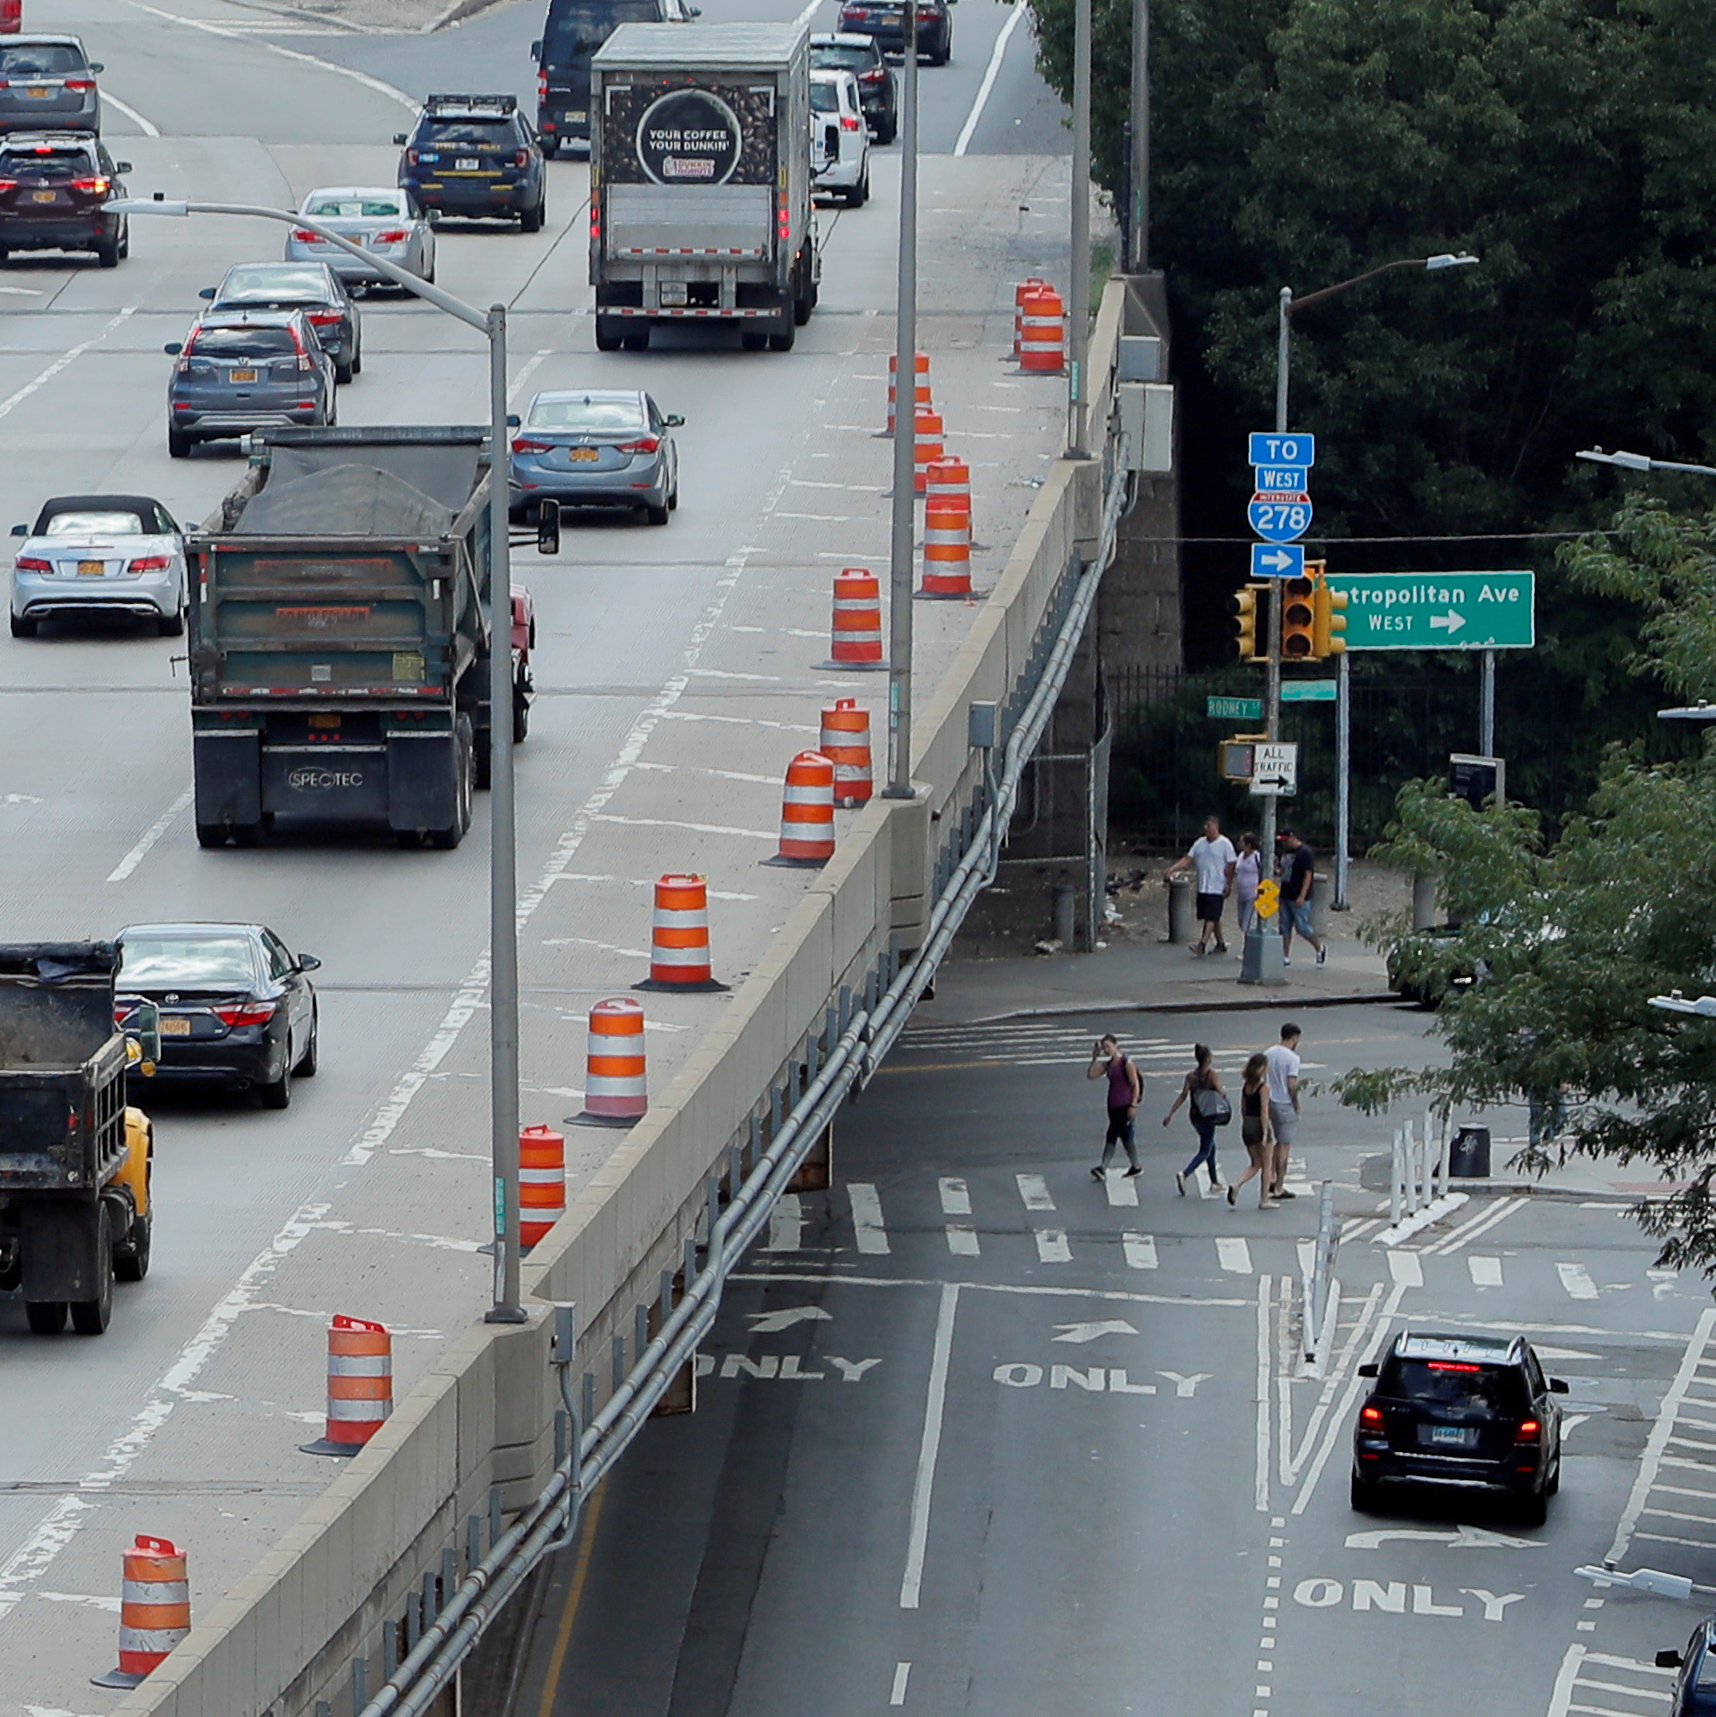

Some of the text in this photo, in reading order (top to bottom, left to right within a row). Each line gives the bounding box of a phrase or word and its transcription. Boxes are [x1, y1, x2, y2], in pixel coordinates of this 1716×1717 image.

[649, 129, 727, 140] YOUR COFFEE
[649, 140, 681, 151] YOUR
[1266, 439, 1298, 460] TO
[1263, 469, 1300, 488] WEST
[1257, 505, 1305, 530] 278
[1478, 585, 1520, 603] Ave
[1369, 614, 1414, 630] WEST
[1208, 700, 1248, 716] RODNEY
[1263, 746, 1284, 759] ALL
[291, 772, 363, 787] SPECTEC
[992, 1361, 1214, 1399] ONLY
[1292, 1577, 1527, 1623] ONLY
